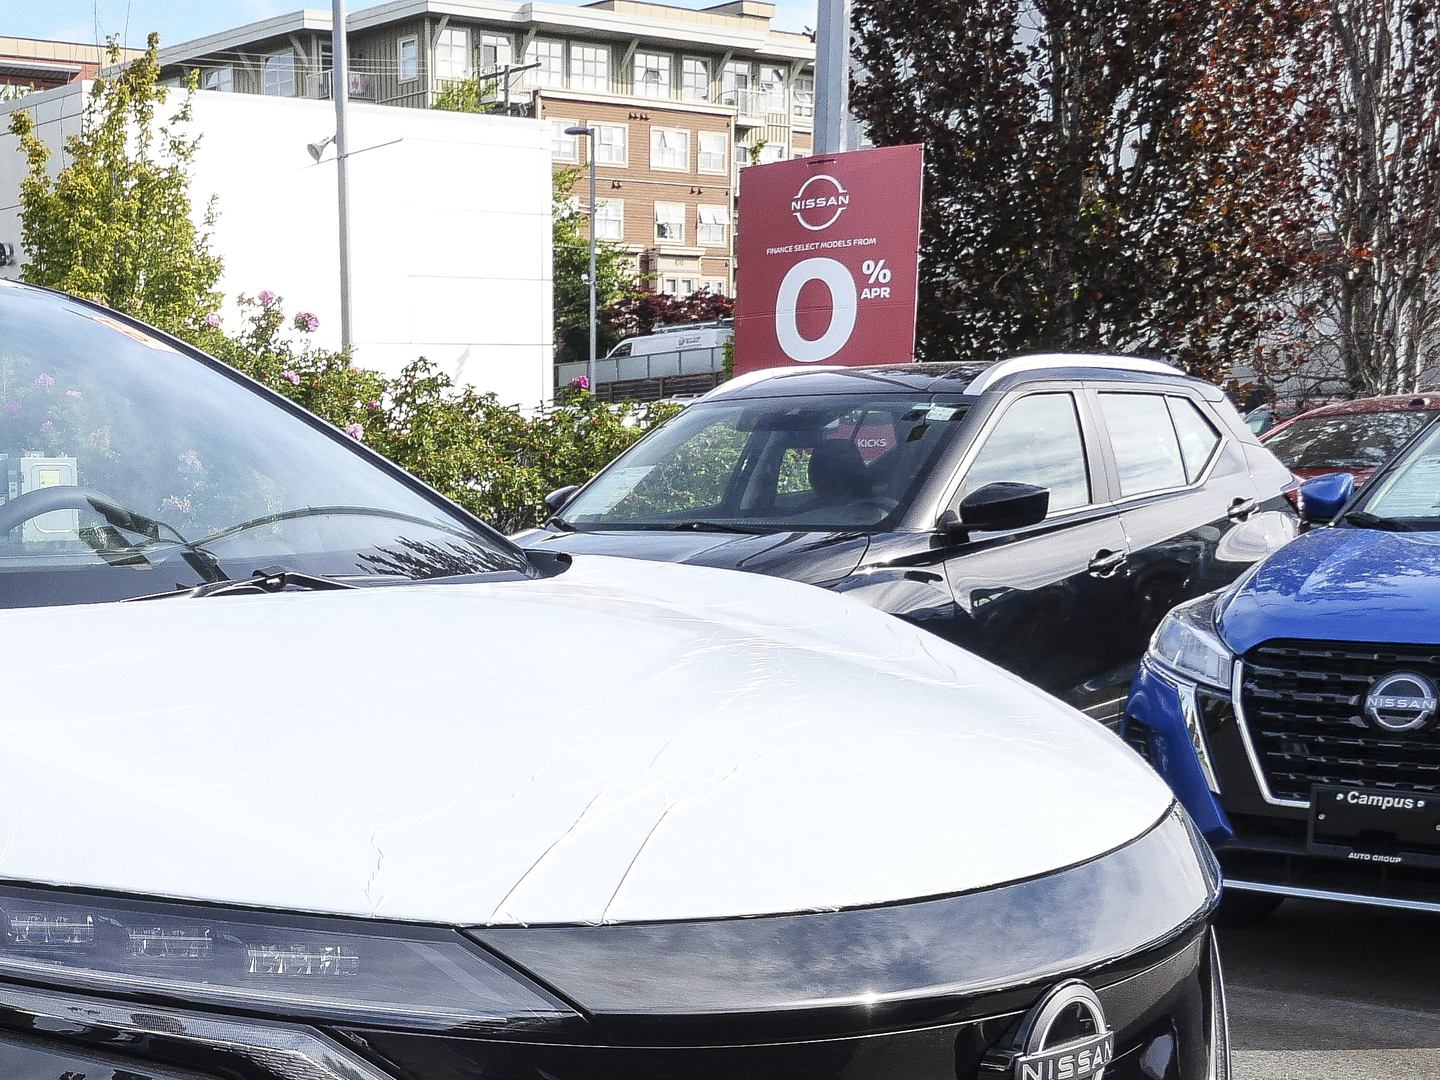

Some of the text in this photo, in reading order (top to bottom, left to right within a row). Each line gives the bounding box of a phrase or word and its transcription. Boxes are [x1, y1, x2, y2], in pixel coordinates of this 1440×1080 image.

[791, 195, 849, 211] NISSAN
[766, 237, 877, 255] FINANCE SELECT MODELS FROM
[860, 287, 890, 300] APR
[775, 257, 892, 362] 0 %
[857, 438, 887, 448] KICKS
[1366, 697, 1435, 710] NISSAN
[1347, 791, 1414, 810] Campus
[1348, 852, 1402, 864] AUTO GROUP
